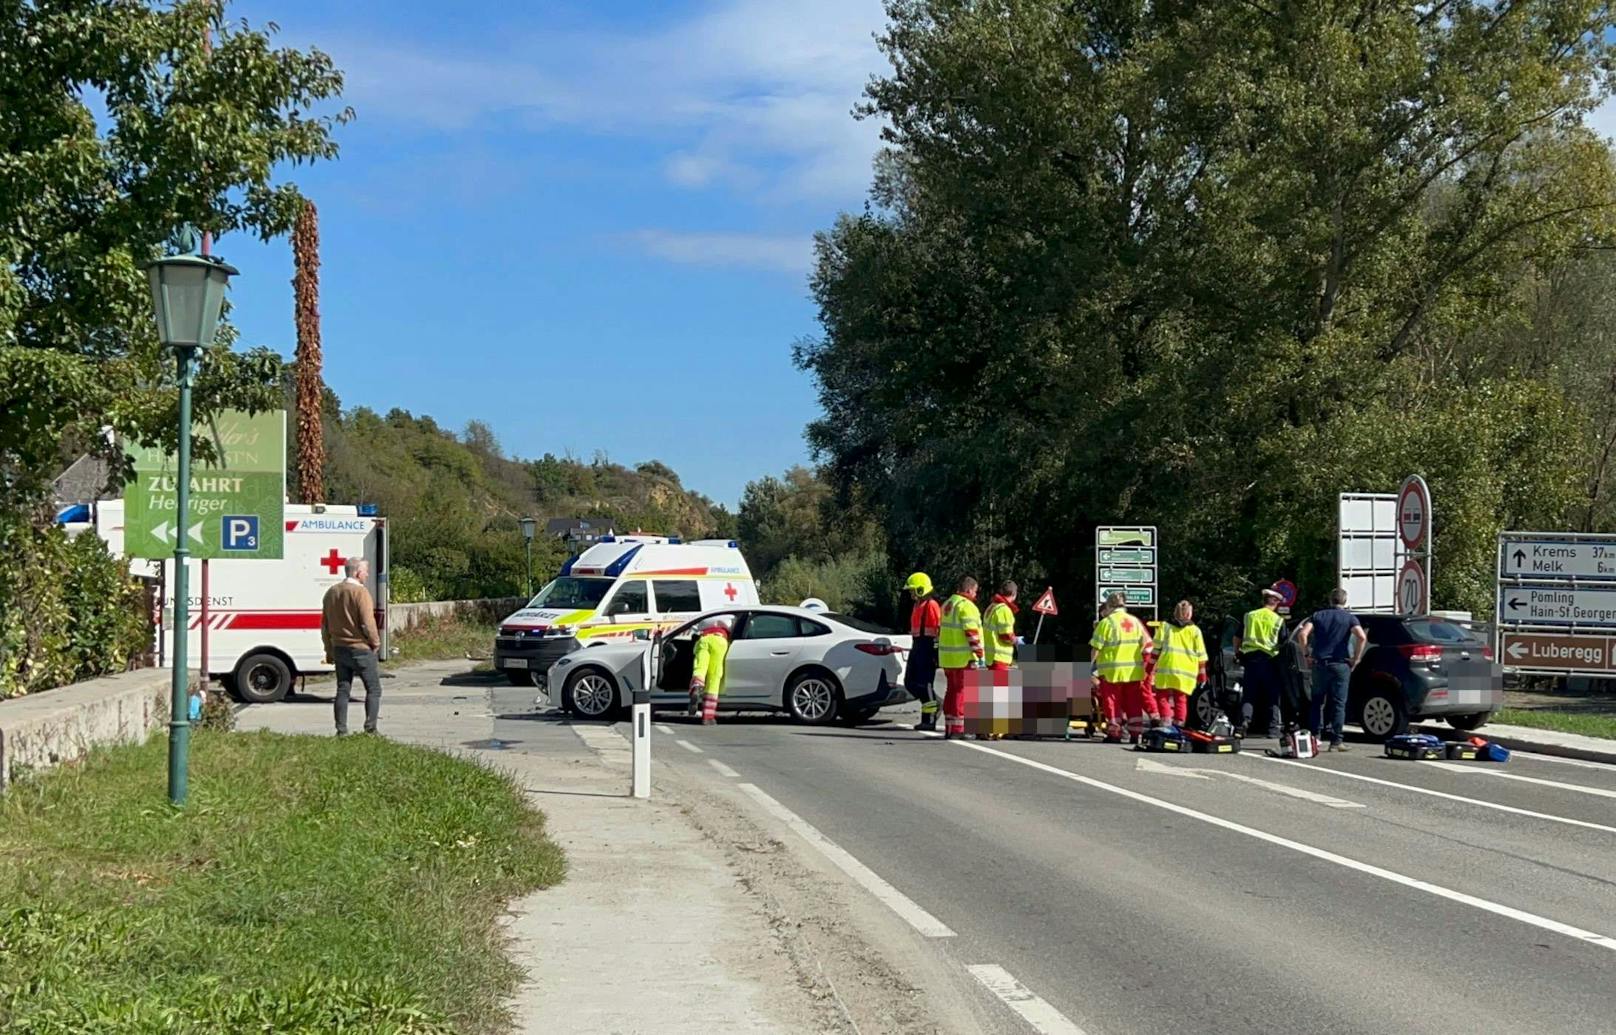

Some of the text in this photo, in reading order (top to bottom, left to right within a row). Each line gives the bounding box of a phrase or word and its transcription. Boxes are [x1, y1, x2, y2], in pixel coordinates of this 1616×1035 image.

[148, 476, 244, 493] ZUAHRT
[148, 495, 228, 516] Heriger
[301, 520, 365, 530] AMBULANCE
[1532, 545, 1577, 558] Krems
[1532, 560, 1564, 572] Melk
[1404, 578, 1418, 609] 70
[1532, 642, 1602, 663] Luberegg
